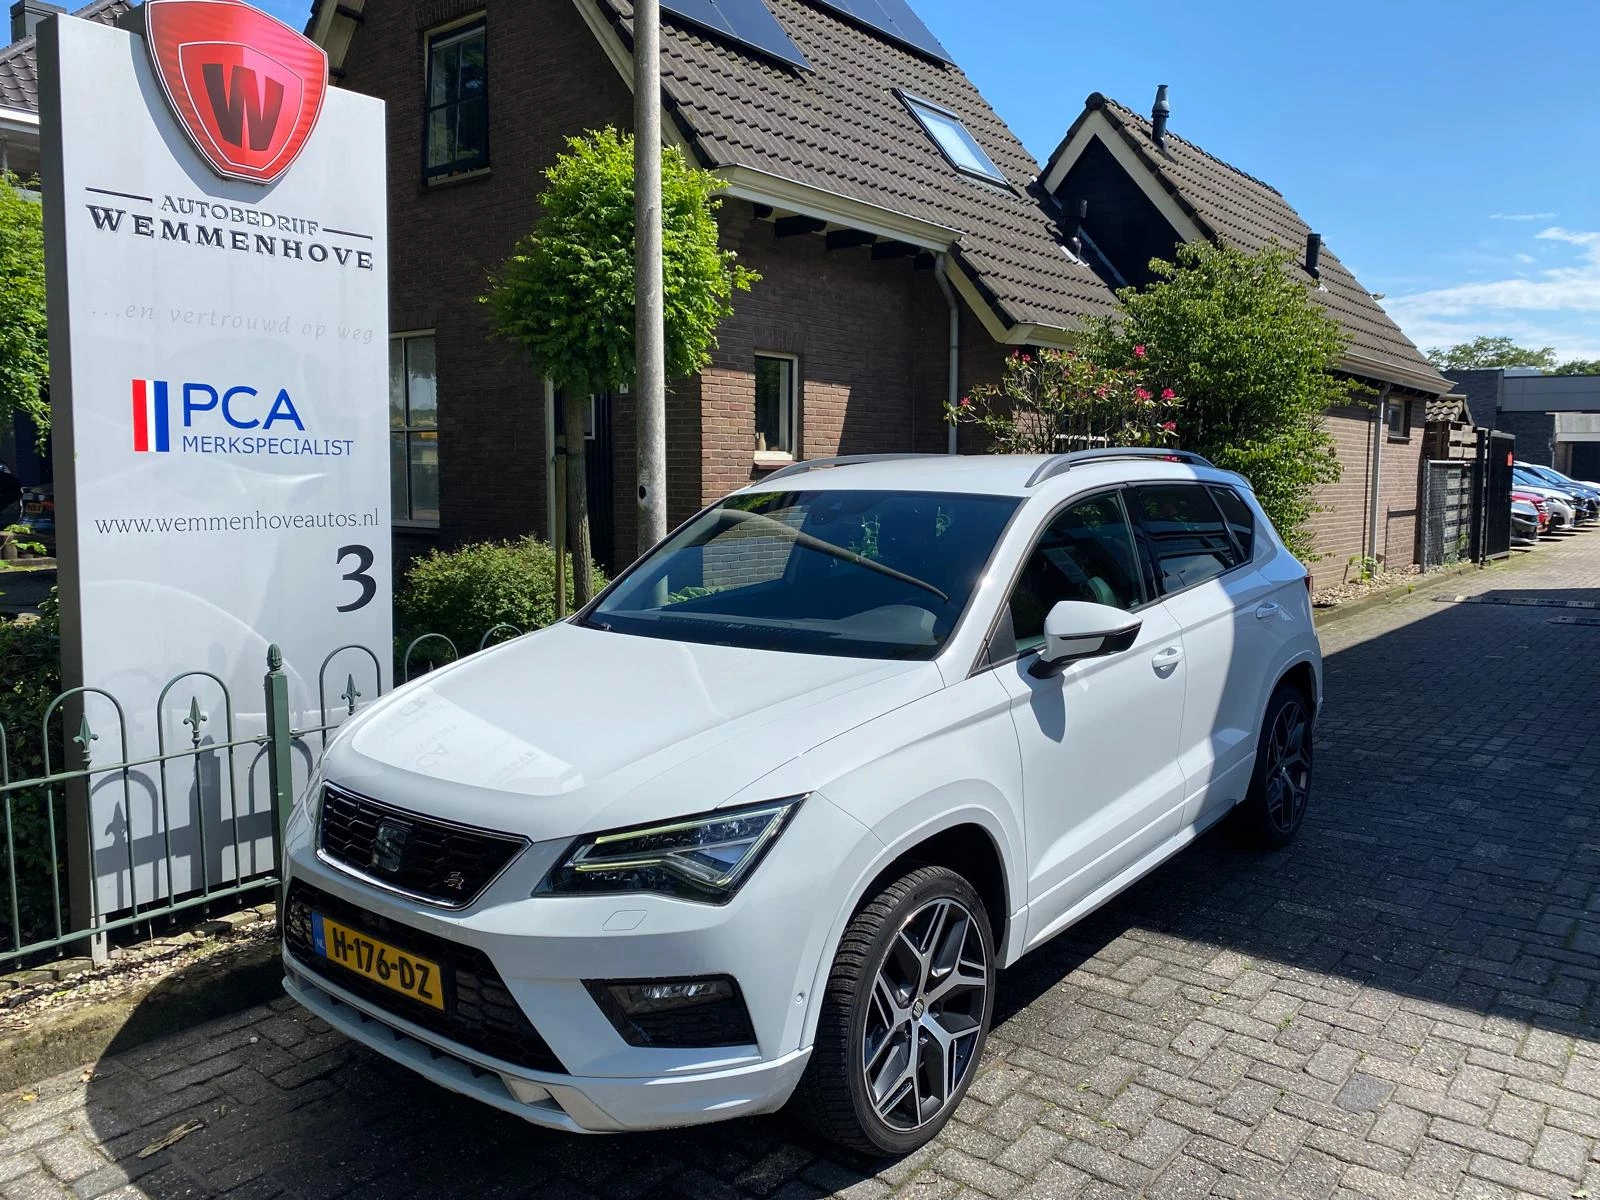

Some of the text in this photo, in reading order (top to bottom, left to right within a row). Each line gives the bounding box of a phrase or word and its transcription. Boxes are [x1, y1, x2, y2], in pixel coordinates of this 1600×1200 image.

[86, 204, 373, 271] WEMMENHOVE
[161, 195, 319, 236] AUTOBEDRIJF
[170, 308, 290, 334] vertrouwd
[302, 322, 326, 340] op
[337, 327, 373, 344] weg
[183, 383, 305, 431] PCA
[183, 435, 353, 456] MERKSPECIALIST
[95, 508, 379, 534] www.wemmenhoveautos.nl
[336, 544, 377, 612] 3
[332, 927, 433, 1000] H-176-DZ
